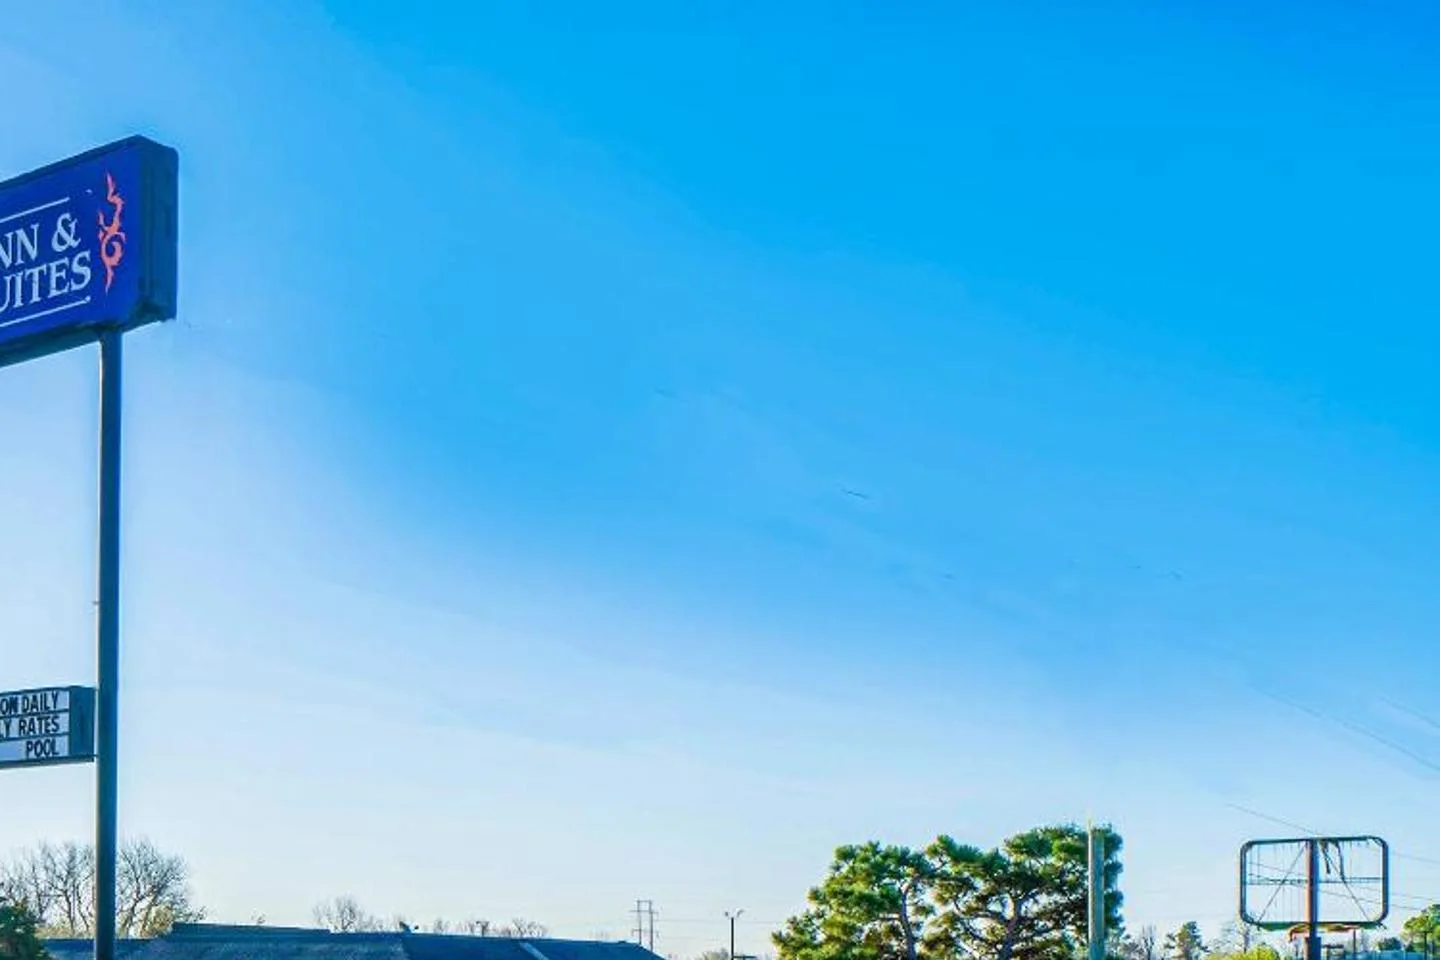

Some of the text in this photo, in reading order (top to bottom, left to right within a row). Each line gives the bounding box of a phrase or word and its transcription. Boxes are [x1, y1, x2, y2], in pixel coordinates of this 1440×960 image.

[50, 212, 82, 253] &
[21, 690, 59, 713] DAILY
[18, 715, 61, 736] RATES
[25, 738, 60, 758] POOL
